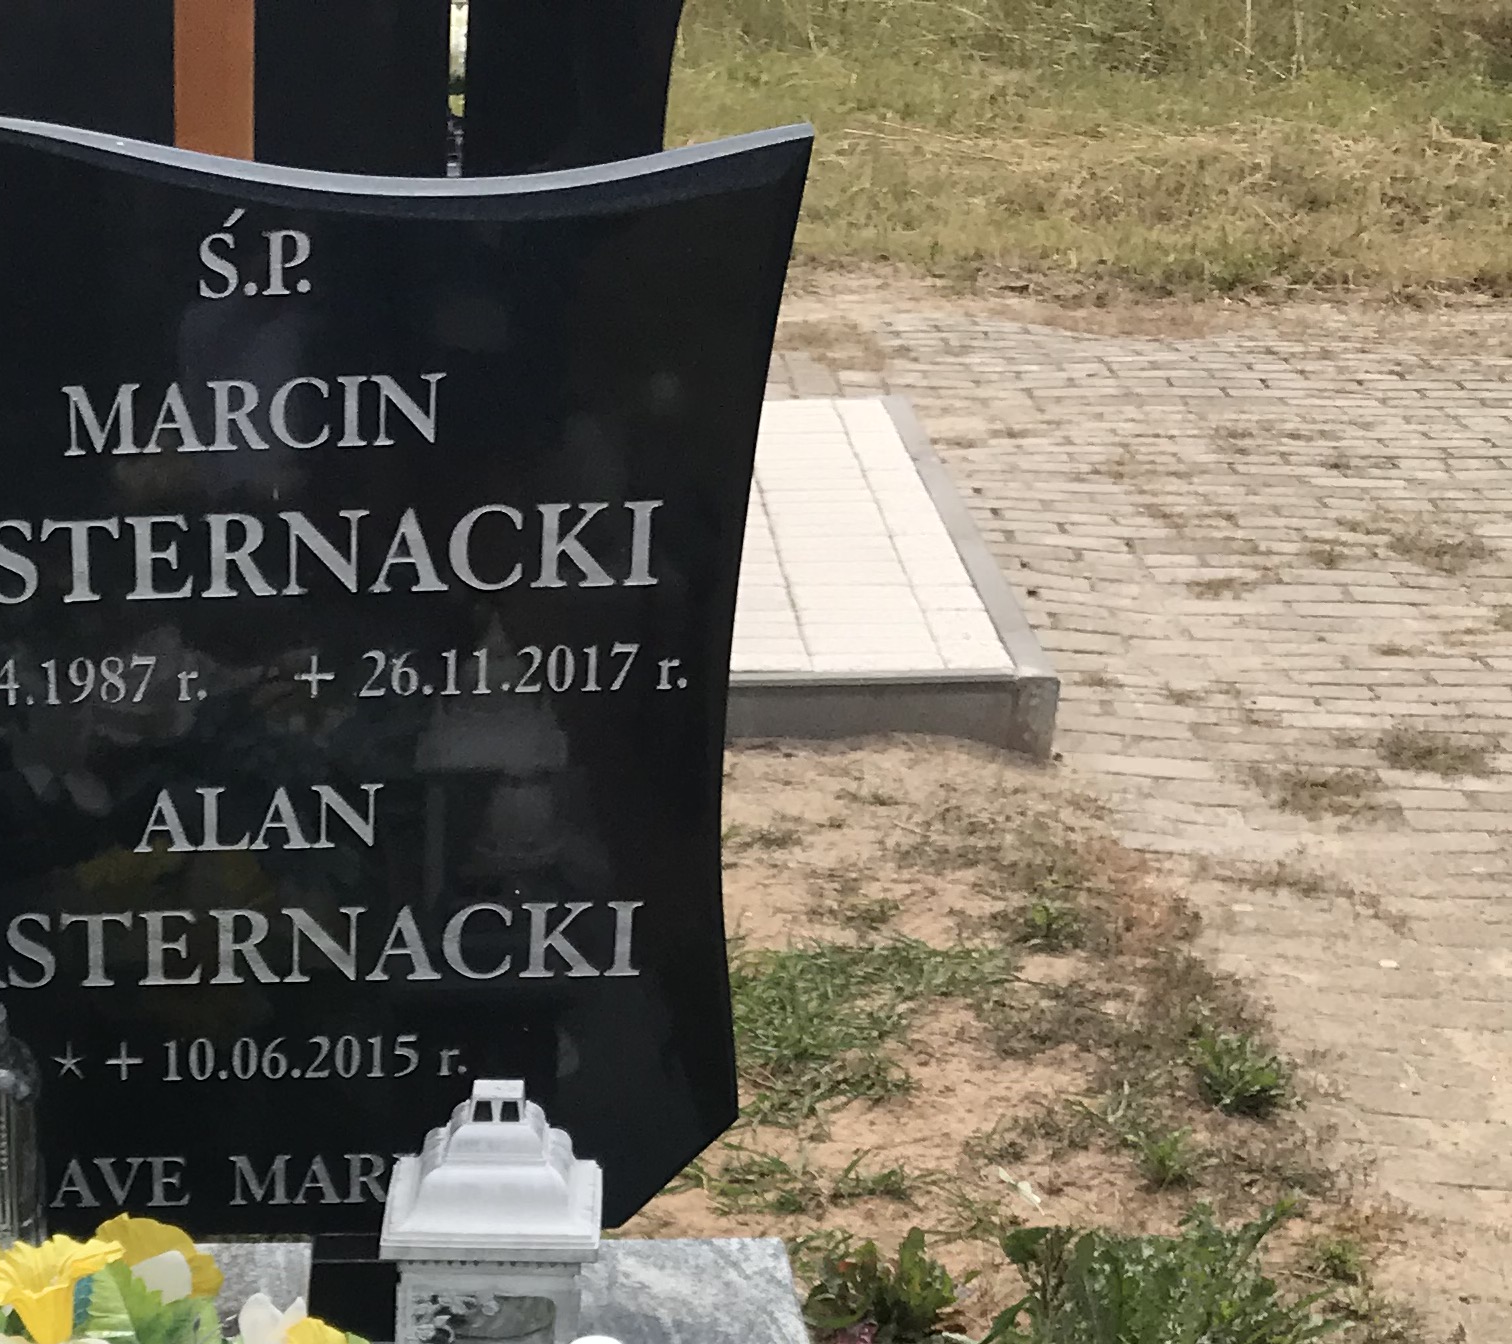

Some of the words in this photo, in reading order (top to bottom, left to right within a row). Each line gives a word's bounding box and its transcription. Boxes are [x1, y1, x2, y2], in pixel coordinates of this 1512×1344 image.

[198, 207, 312, 300] Ś.P.
[60, 371, 448, 458] MARCIN
[176, 669, 209, 703] r.
[357, 641, 641, 699] 26.11.2017
[656, 657, 689, 691] r.
[132, 782, 385, 854] ALAN
[161, 1034, 420, 1082] 10.06.2015
[438, 1047, 468, 1077] r.
[49, 1155, 191, 1209] AVE
[227, 1152, 416, 1206] MAR
